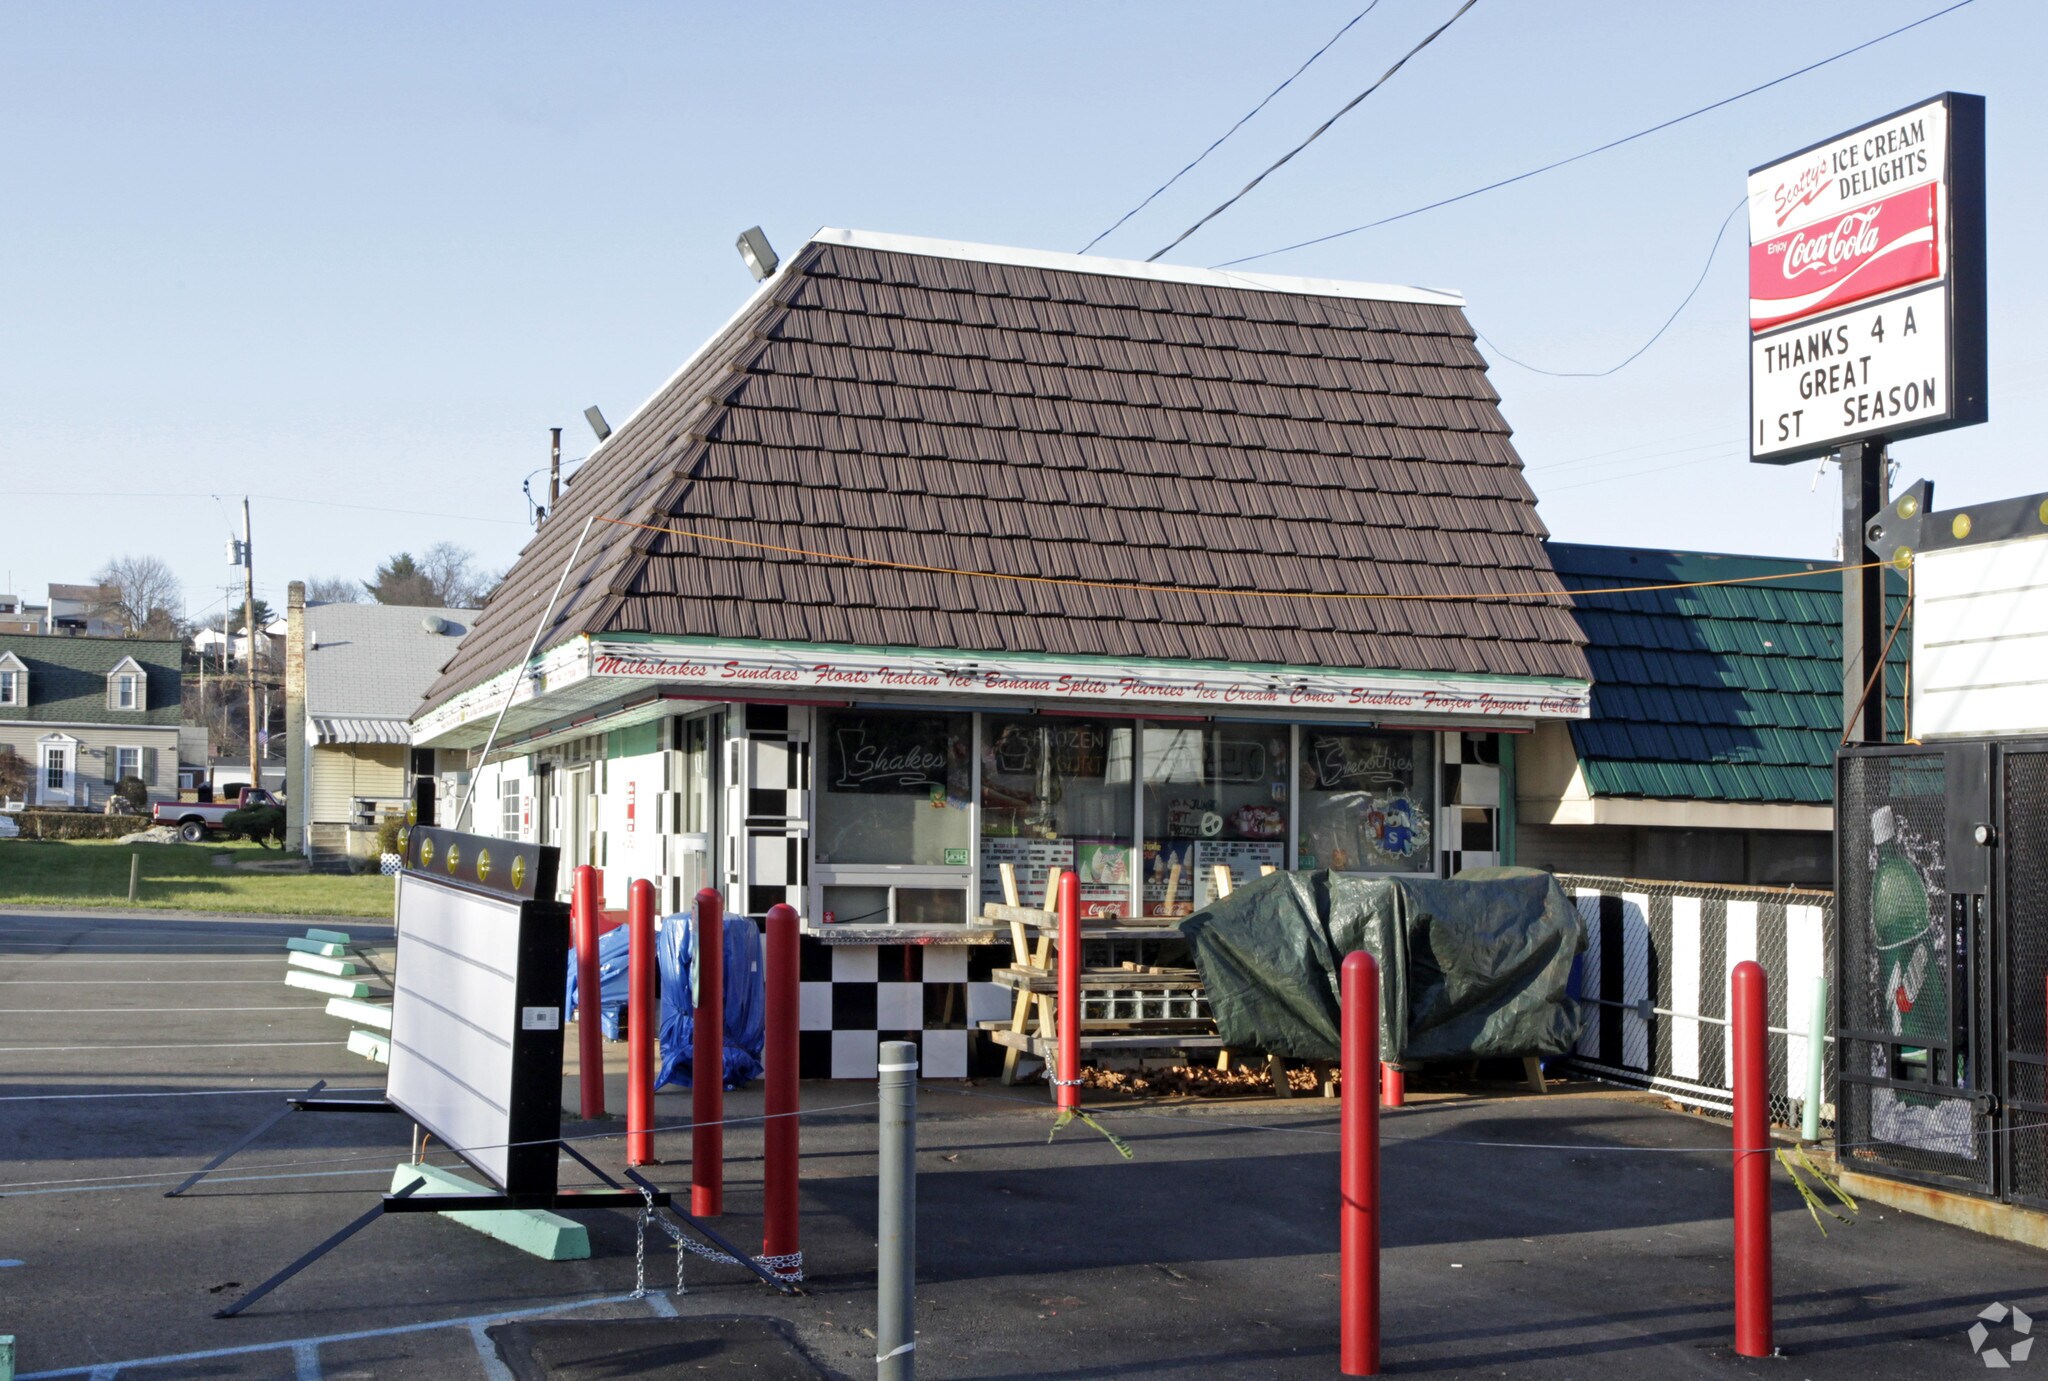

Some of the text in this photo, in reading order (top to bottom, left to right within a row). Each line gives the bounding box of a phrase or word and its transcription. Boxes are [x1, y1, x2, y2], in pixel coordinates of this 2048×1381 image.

[1833, 119, 1925, 175] ICE CREAM
[1774, 157, 1828, 215] Scotty's
[1839, 149, 1928, 201] DELIGHTS
[1767, 203, 1884, 280] Enjoy Coca-Cola
[1765, 306, 1918, 374] THANKS 4 A
[1799, 355, 1872, 400] GREAT
[1843, 377, 1936, 427] SEASON
[594, 655, 708, 676] Milkshakes
[720, 660, 800, 682] Sundaes
[812, 664, 870, 685] Floats
[877, 667, 941, 687] Italian
[946, 671, 972, 688] Ice
[984, 671, 1051, 691] Banana
[1056, 675, 1109, 696] Splits
[1118, 677, 1186, 698] Flurries
[1192, 682, 1219, 700] Ice
[1224, 683, 1279, 703] Cream
[1289, 684, 1336, 704] Cones
[1348, 688, 1413, 707] Slushies
[1422, 691, 1474, 713] Frozen
[1479, 693, 1530, 714] Yogurt
[849, 745, 946, 777] Shakes
[1323, 746, 1413, 784] Smoothies
[1389, 832, 1399, 844] S
